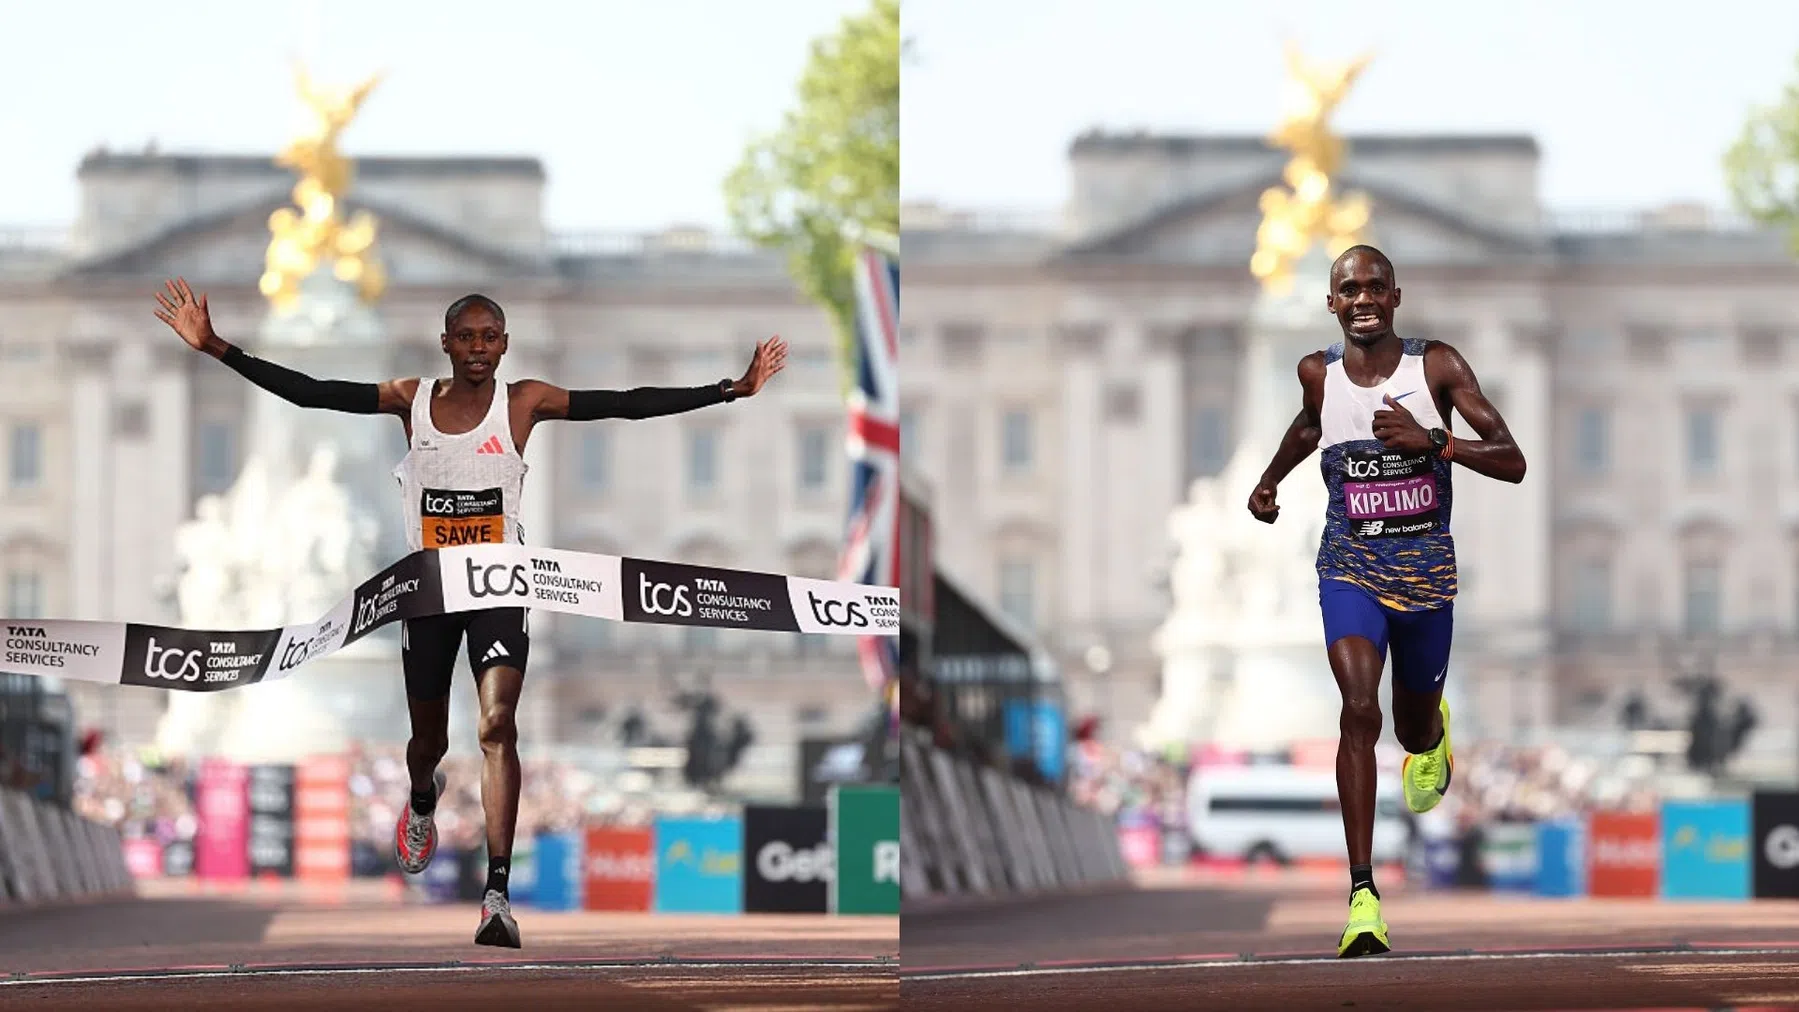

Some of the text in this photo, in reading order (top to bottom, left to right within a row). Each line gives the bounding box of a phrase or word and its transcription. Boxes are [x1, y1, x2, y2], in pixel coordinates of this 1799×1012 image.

[1348, 457, 1380, 477] tcs
[1382, 456, 1426, 469] CONSULTANCY
[1383, 467, 1412, 476] SERVICES
[426, 493, 454, 513] tcs
[1350, 484, 1433, 514] KIPLIMO
[435, 524, 491, 545] SAWE
[1402, 522, 1433, 532] balance
[531, 558, 561, 573] TATA
[466, 557, 529, 598] tcs
[533, 573, 602, 593] CONSULTANCY
[695, 578, 727, 592] TATA
[378, 578, 420, 606] CONSULTANCY
[535, 588, 579, 604] SERVICES
[640, 572, 693, 617] tcs
[864, 595, 898, 606] TATA
[375, 600, 398, 621] SERVICES
[697, 594, 772, 610] CONSULTANCY
[808, 591, 868, 627] tcs
[354, 594, 379, 634] tcs
[699, 608, 749, 621] SERVICES
[7, 626, 46, 637] TATA
[6, 638, 99, 656] CONSULTANCY
[209, 642, 236, 653] TATA
[279, 636, 314, 671] tcs
[6, 651, 64, 667] SERVICES
[145, 637, 202, 681] tcs
[206, 654, 262, 668] CONSULTANCY
[204, 669, 239, 682] SERVICES
